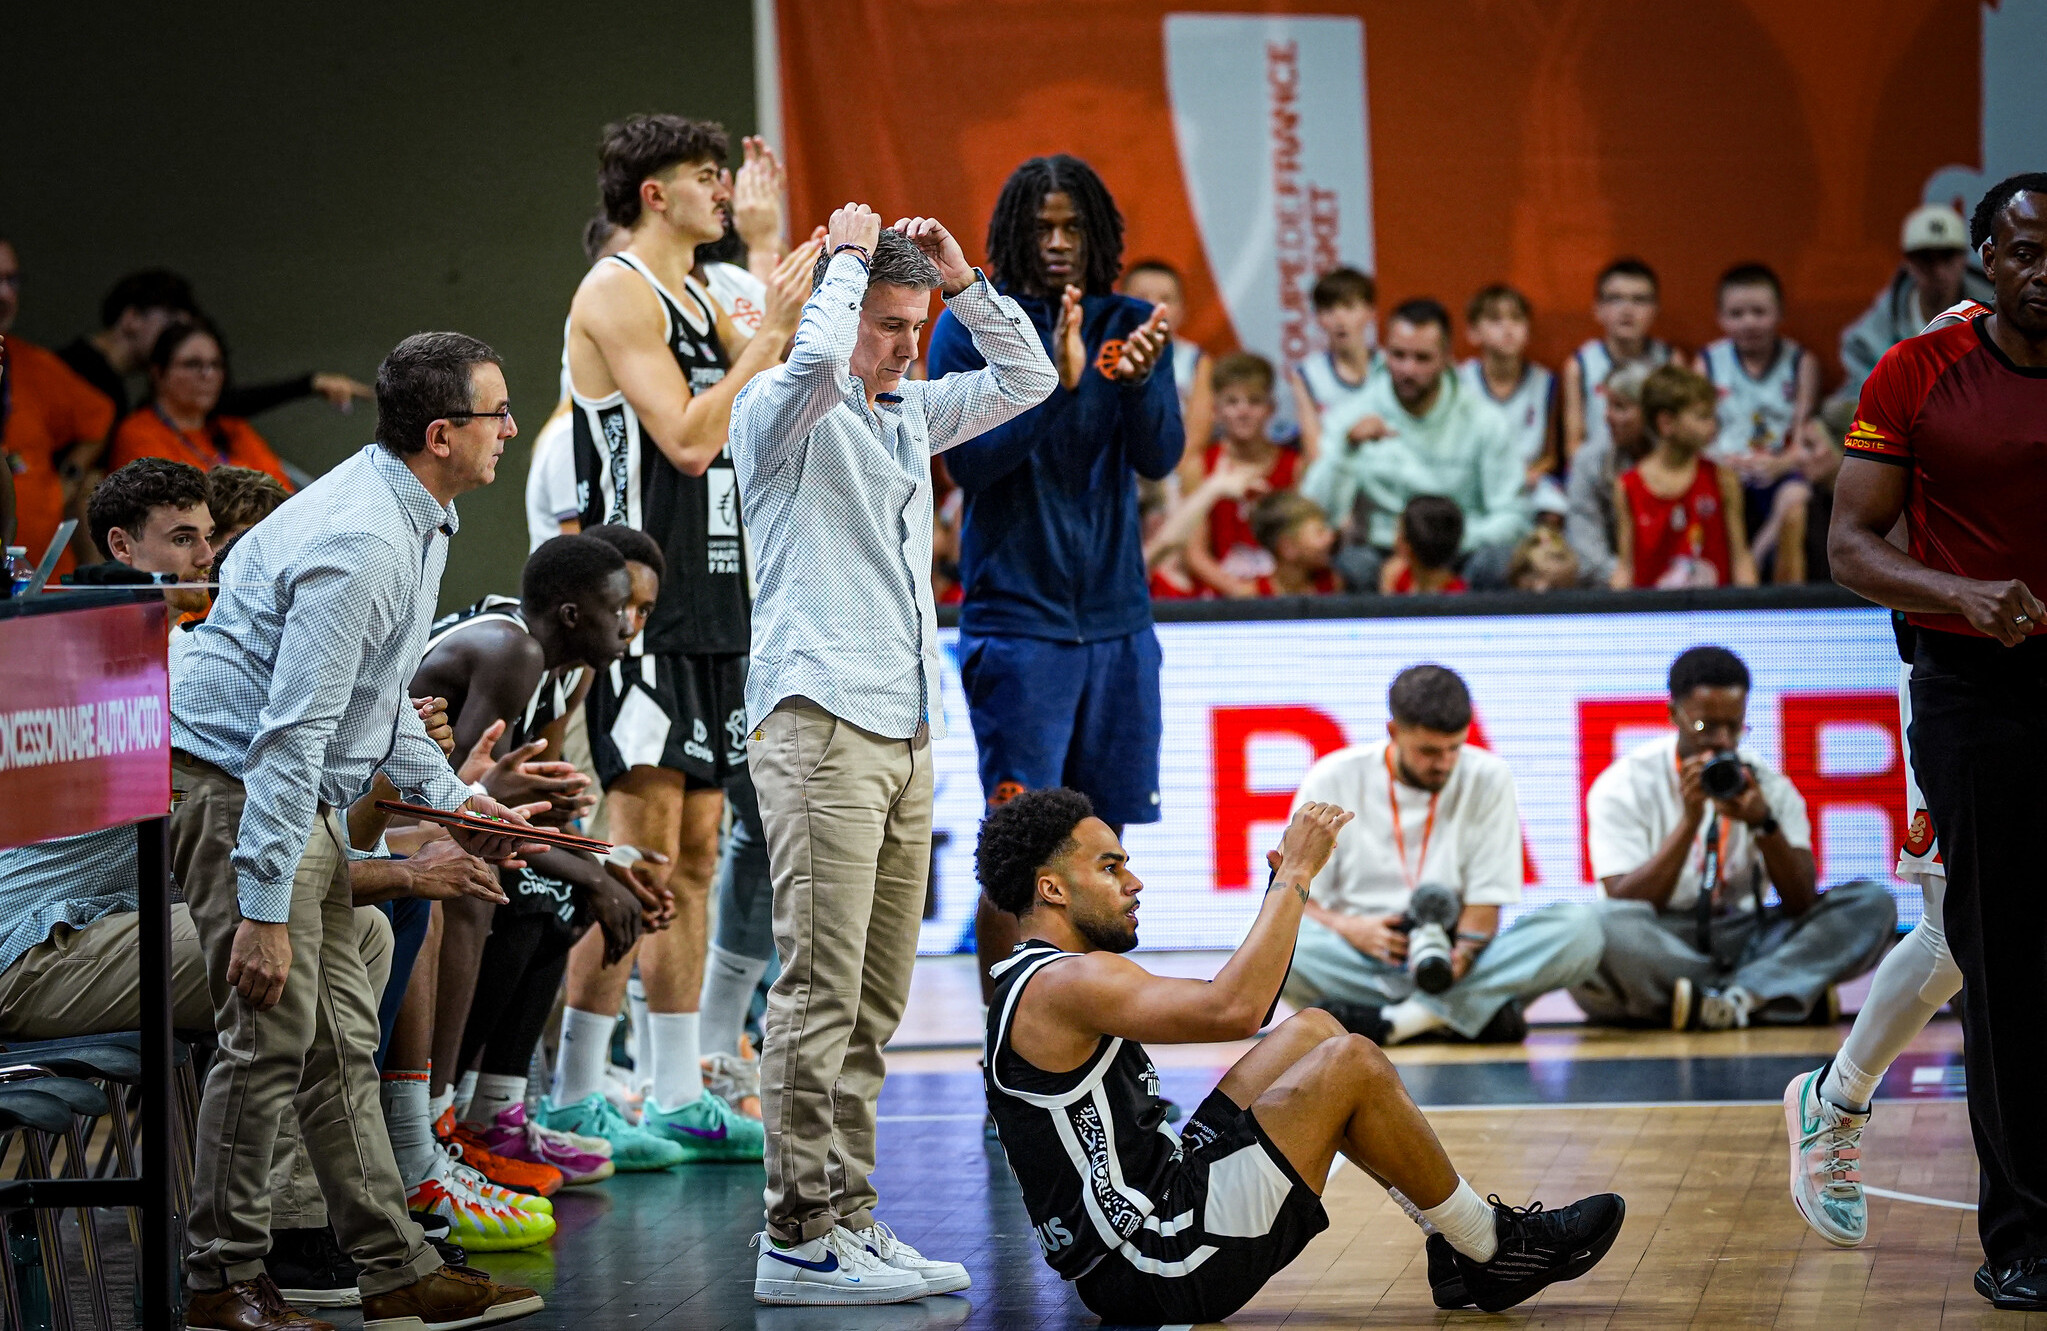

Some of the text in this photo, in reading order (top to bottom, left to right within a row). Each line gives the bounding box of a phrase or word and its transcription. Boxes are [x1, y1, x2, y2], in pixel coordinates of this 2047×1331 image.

[1266, 39, 1302, 197] FRANCE
[0, 695, 162, 771] ONCESSIONNAIRE AUTO MOTO
[1032, 1216, 1074, 1258] US
